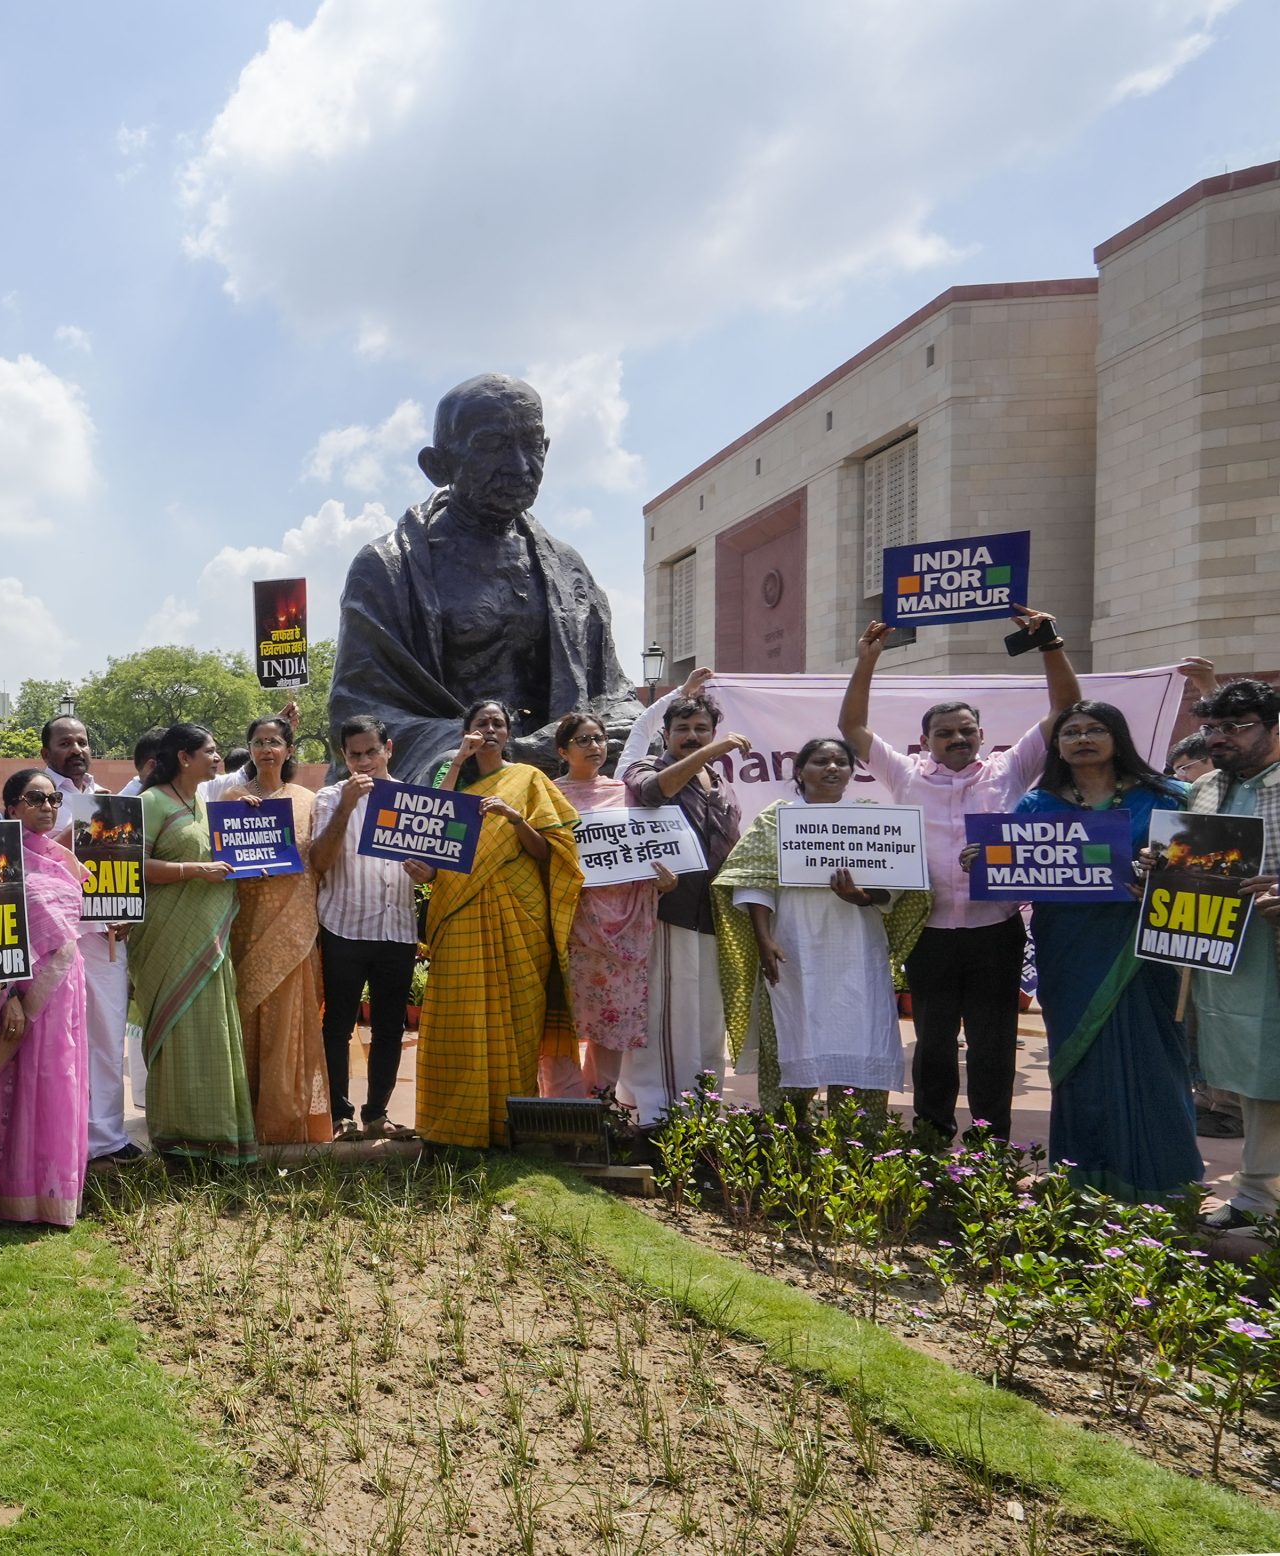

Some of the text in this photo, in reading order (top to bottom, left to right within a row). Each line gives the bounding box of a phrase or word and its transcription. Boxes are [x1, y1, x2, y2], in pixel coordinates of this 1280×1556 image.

[913, 546, 994, 573] INDIA
[923, 569, 982, 592] FOR
[897, 587, 1010, 613] MANIPUR
[262, 656, 307, 678] INDIA
[393, 791, 455, 819] INDIA
[223, 816, 277, 830] PM START
[398, 812, 445, 836] FOR
[573, 818, 683, 845] मणिपुर के साथ
[795, 823, 902, 836] INDIA Demand PM
[1001, 822, 1090, 842] INDIA
[222, 829, 282, 847] PARLIAMENT
[372, 828, 463, 857] MANIPUR
[782, 840, 916, 855] statement on Manipur
[234, 847, 277, 862] DEBATE
[582, 840, 681, 870] खड़ा है इंडिया
[805, 855, 817, 867] in
[820, 856, 887, 870] Parliament
[1015, 845, 1078, 865] FOR
[82, 859, 140, 894] SAVE
[986, 867, 1113, 885] MANIPUR
[82, 896, 143, 917] MANIPUR
[1149, 888, 1241, 938] SAVE
[1141, 928, 1234, 967] MANIPUR
